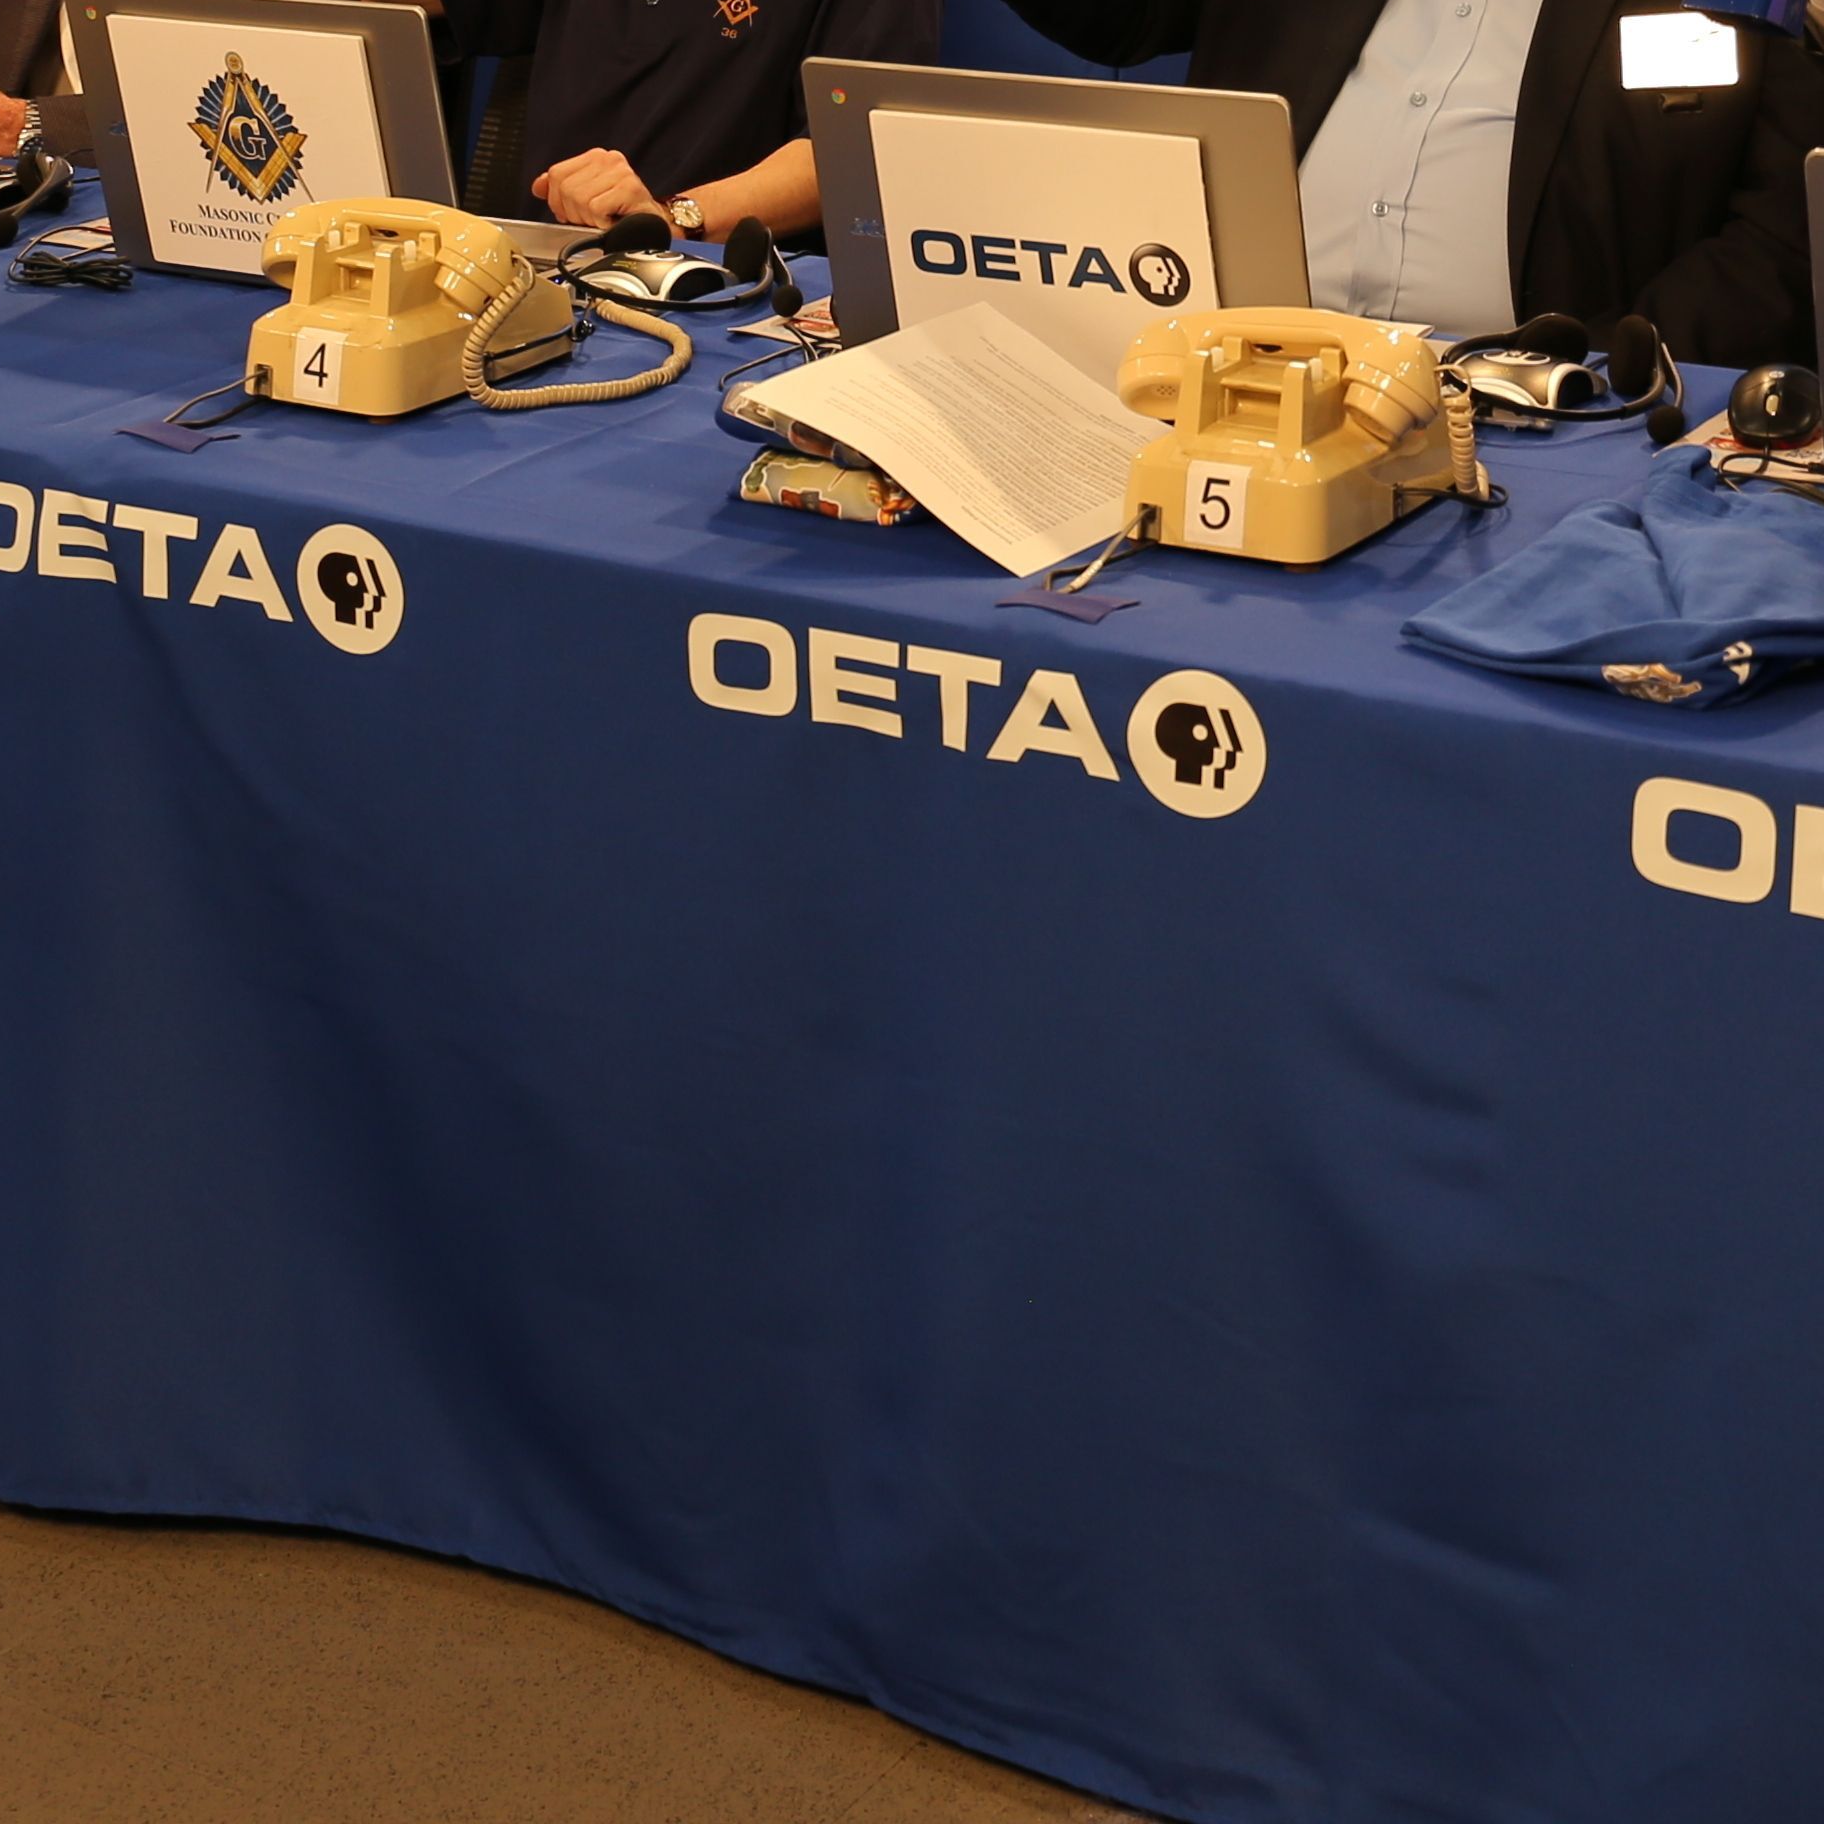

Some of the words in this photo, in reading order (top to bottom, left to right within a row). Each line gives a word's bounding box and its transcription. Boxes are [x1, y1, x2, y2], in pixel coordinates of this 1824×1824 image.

[169, 219, 263, 243] FOUNDATION
[198, 204, 265, 226] MASONIC
[910, 229, 1127, 294] OETA
[303, 343, 329, 388] 4
[1199, 477, 1231, 530] 5
[687, 612, 1120, 782] OETA
